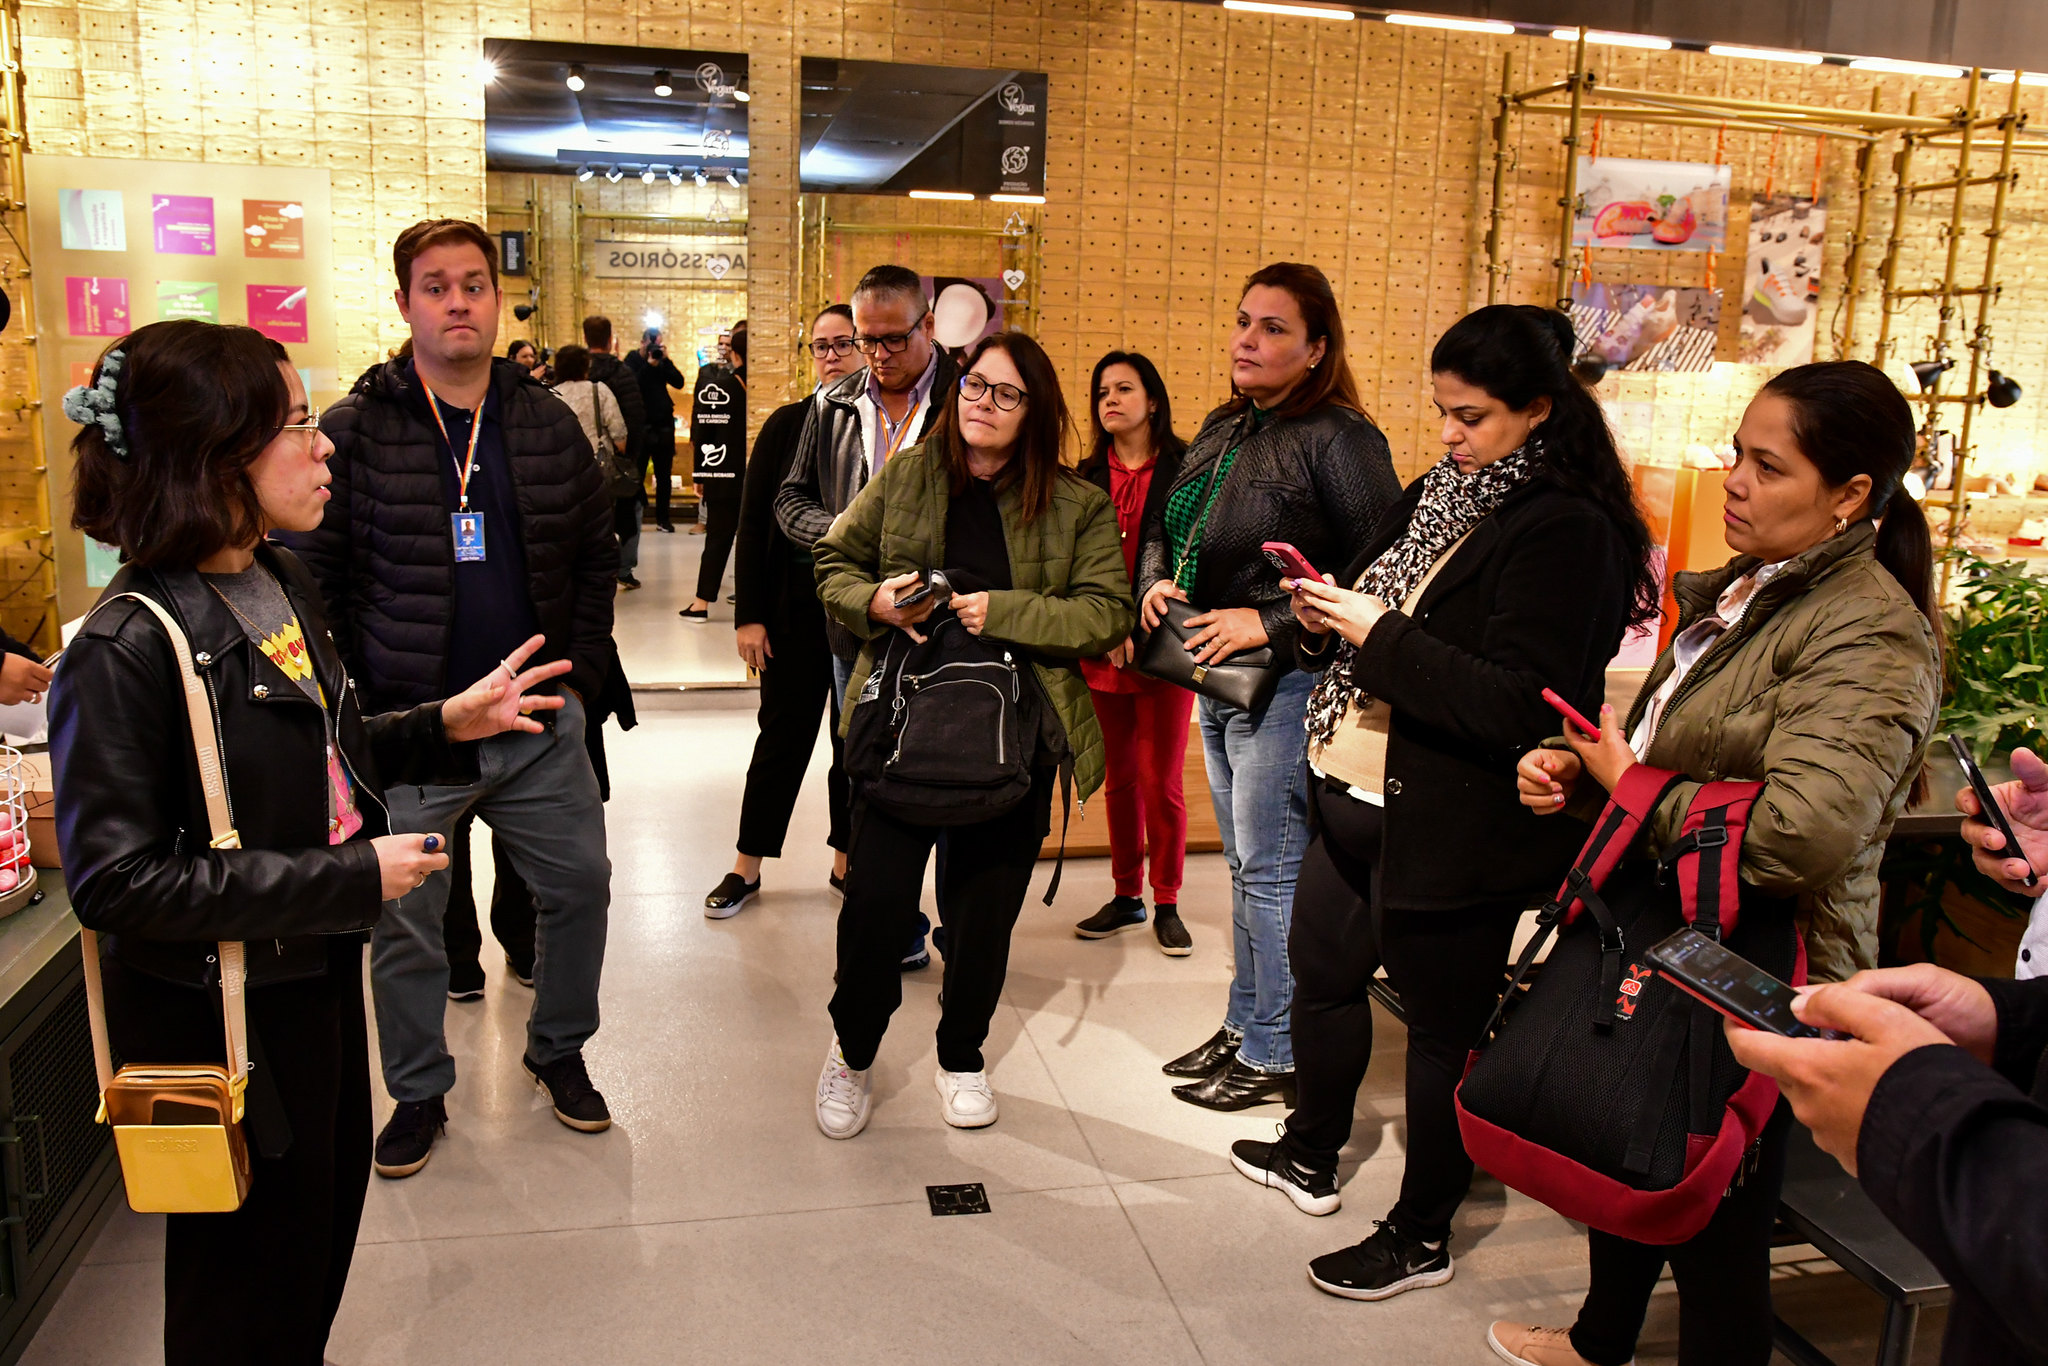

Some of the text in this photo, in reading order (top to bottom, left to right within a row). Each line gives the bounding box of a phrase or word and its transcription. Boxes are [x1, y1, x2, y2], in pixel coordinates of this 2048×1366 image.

[703, 79, 735, 97] Vegan
[1005, 98, 1035, 115] Vegan
[707, 391, 719, 401] CO2
[176, 642, 200, 695] melissa
[200, 745, 221, 799] melissa
